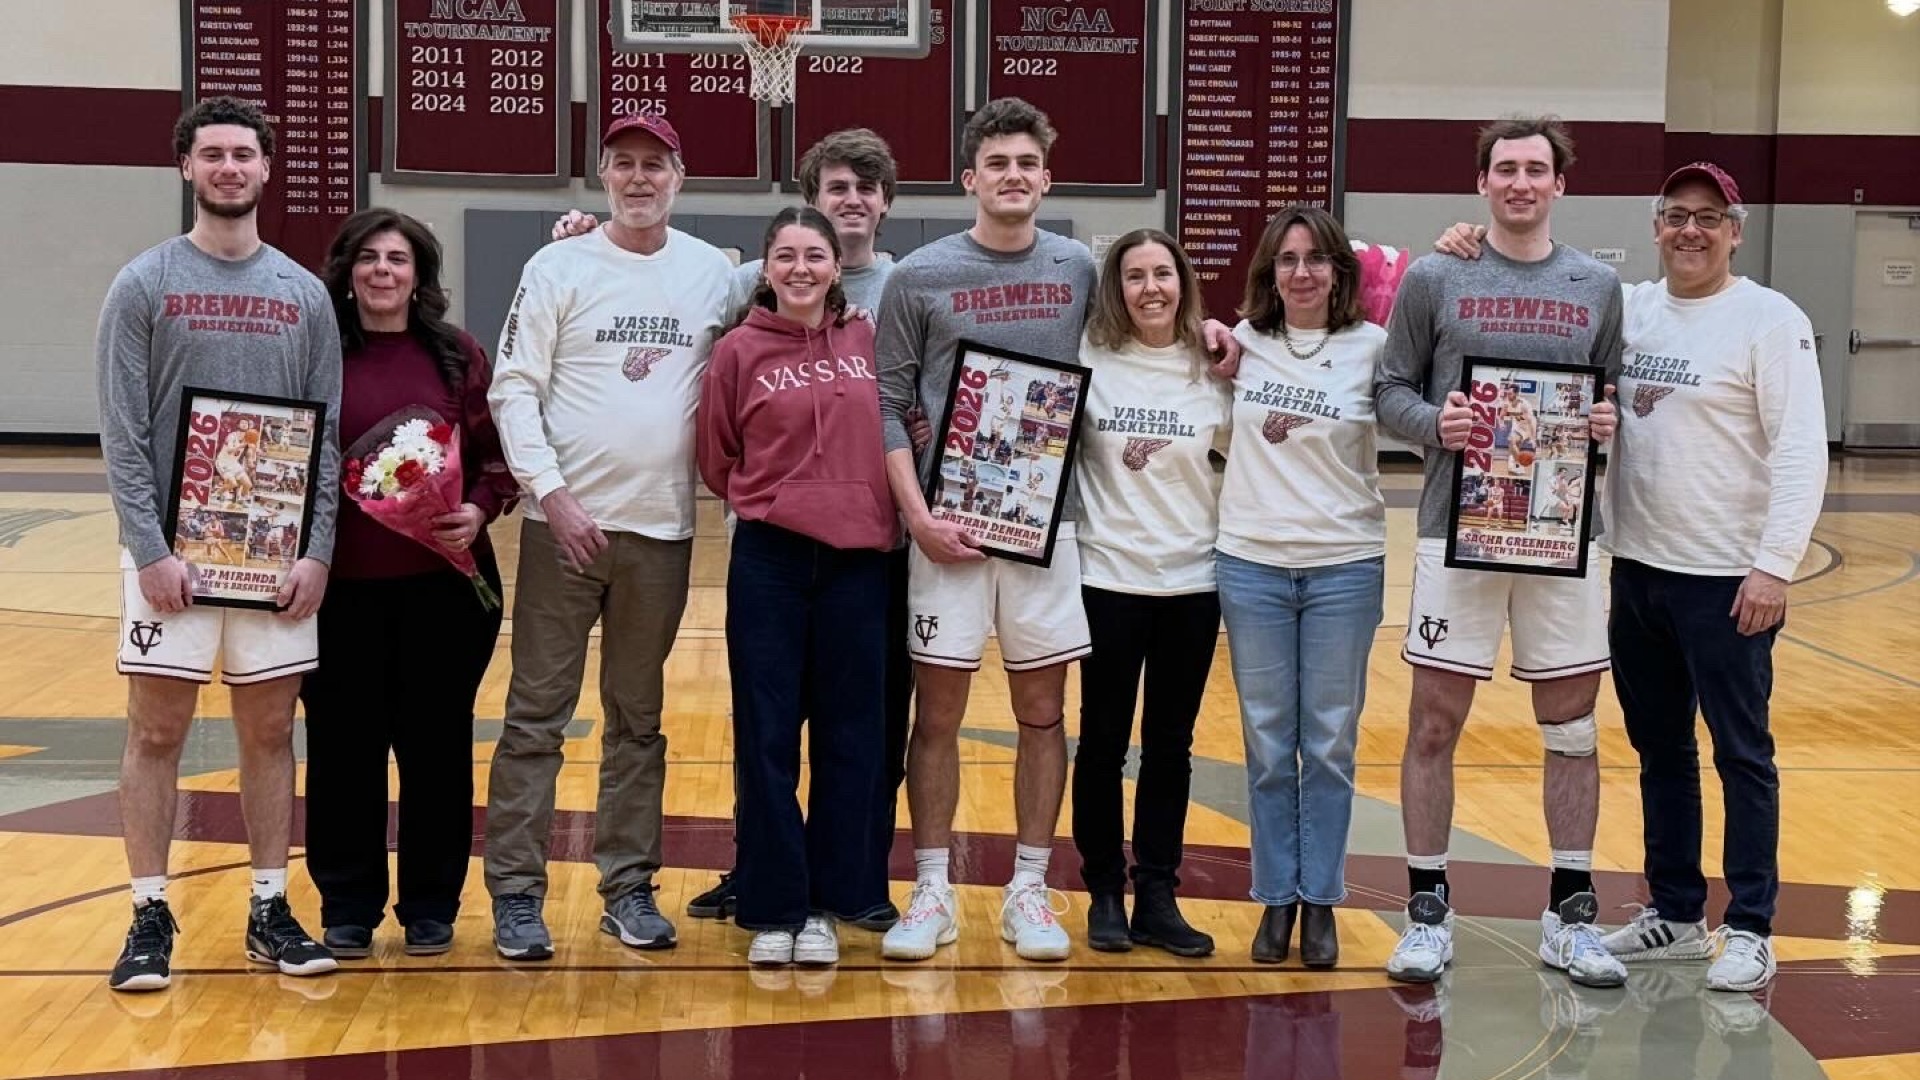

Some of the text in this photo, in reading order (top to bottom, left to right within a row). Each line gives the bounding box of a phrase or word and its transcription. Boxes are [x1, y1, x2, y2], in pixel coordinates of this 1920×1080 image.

[429, 0, 526, 22] NCAA
[1189, 0, 1333, 13] POINT SCORERS
[1020, 6, 1115, 33] NCAA
[1200, 19, 1232, 28] PITTMAN
[404, 22, 552, 42] TOURNAMENT
[1189, 34, 1217, 42] ROBERT
[996, 35, 1140, 54] TOURNAMENT
[411, 46, 544, 68] 2011 2012
[611, 52, 745, 71] 2011 2012
[808, 55, 863, 74] 2022
[200, 66, 224, 76] EMILY
[1003, 58, 1057, 76] 2022
[1188, 63, 1207, 72] MIKE
[200, 82, 236, 91] BRITTANY
[238, 83, 263, 92] PARKS
[411, 69, 544, 91] 2014 2019
[611, 74, 746, 94] 2014 2024
[1187, 79, 1207, 88] DAVE
[286, 99, 318, 109] 2010-14
[411, 92, 544, 115] 2024 2025
[611, 98, 668, 116] 2025
[286, 115, 318, 125] 2010-14
[1186, 152, 1215, 161] JUDSON
[1186, 168, 1225, 177] LAWRENCE
[1186, 183, 1208, 191] TYSON
[1208, 199, 1261, 208] BUTTERWORTH
[1184, 213, 1203, 221] ALEX
[1184, 242, 1205, 250] JESSE
[950, 282, 1074, 314] BREWERS
[163, 293, 301, 325] BREWERS
[975, 307, 1061, 325] BASKETBALL
[1457, 295, 1590, 329] BREWERS
[188, 319, 281, 336] BASKETBALL
[612, 315, 680, 333] VASSAR
[1479, 322, 1573, 338] BASKETBALL
[595, 329, 694, 348] BASKETBALL
[1633, 352, 1690, 372] VASSAR
[756, 355, 877, 393] VASSAR
[1262, 380, 1328, 404] VASSAR
[945, 364, 988, 457] 2026
[1112, 405, 1180, 424] VASSAR
[1243, 390, 1342, 421] BASKETBALL
[1097, 418, 1196, 437] BASKETBALL
[1463, 379, 1499, 474] 2026
[180, 411, 220, 507] 2026
[938, 510, 989, 530] NATHAN
[986, 521, 1042, 542] DENHAM
[984, 531, 1041, 550] BASKETBALL
[1463, 532, 1577, 552] SACHA GREENBERG
[1515, 548, 1571, 559] BASKETBALL
[200, 568, 278, 585] JP MIRANDA
[199, 579, 283, 594] MEN'S BASKETBAL
